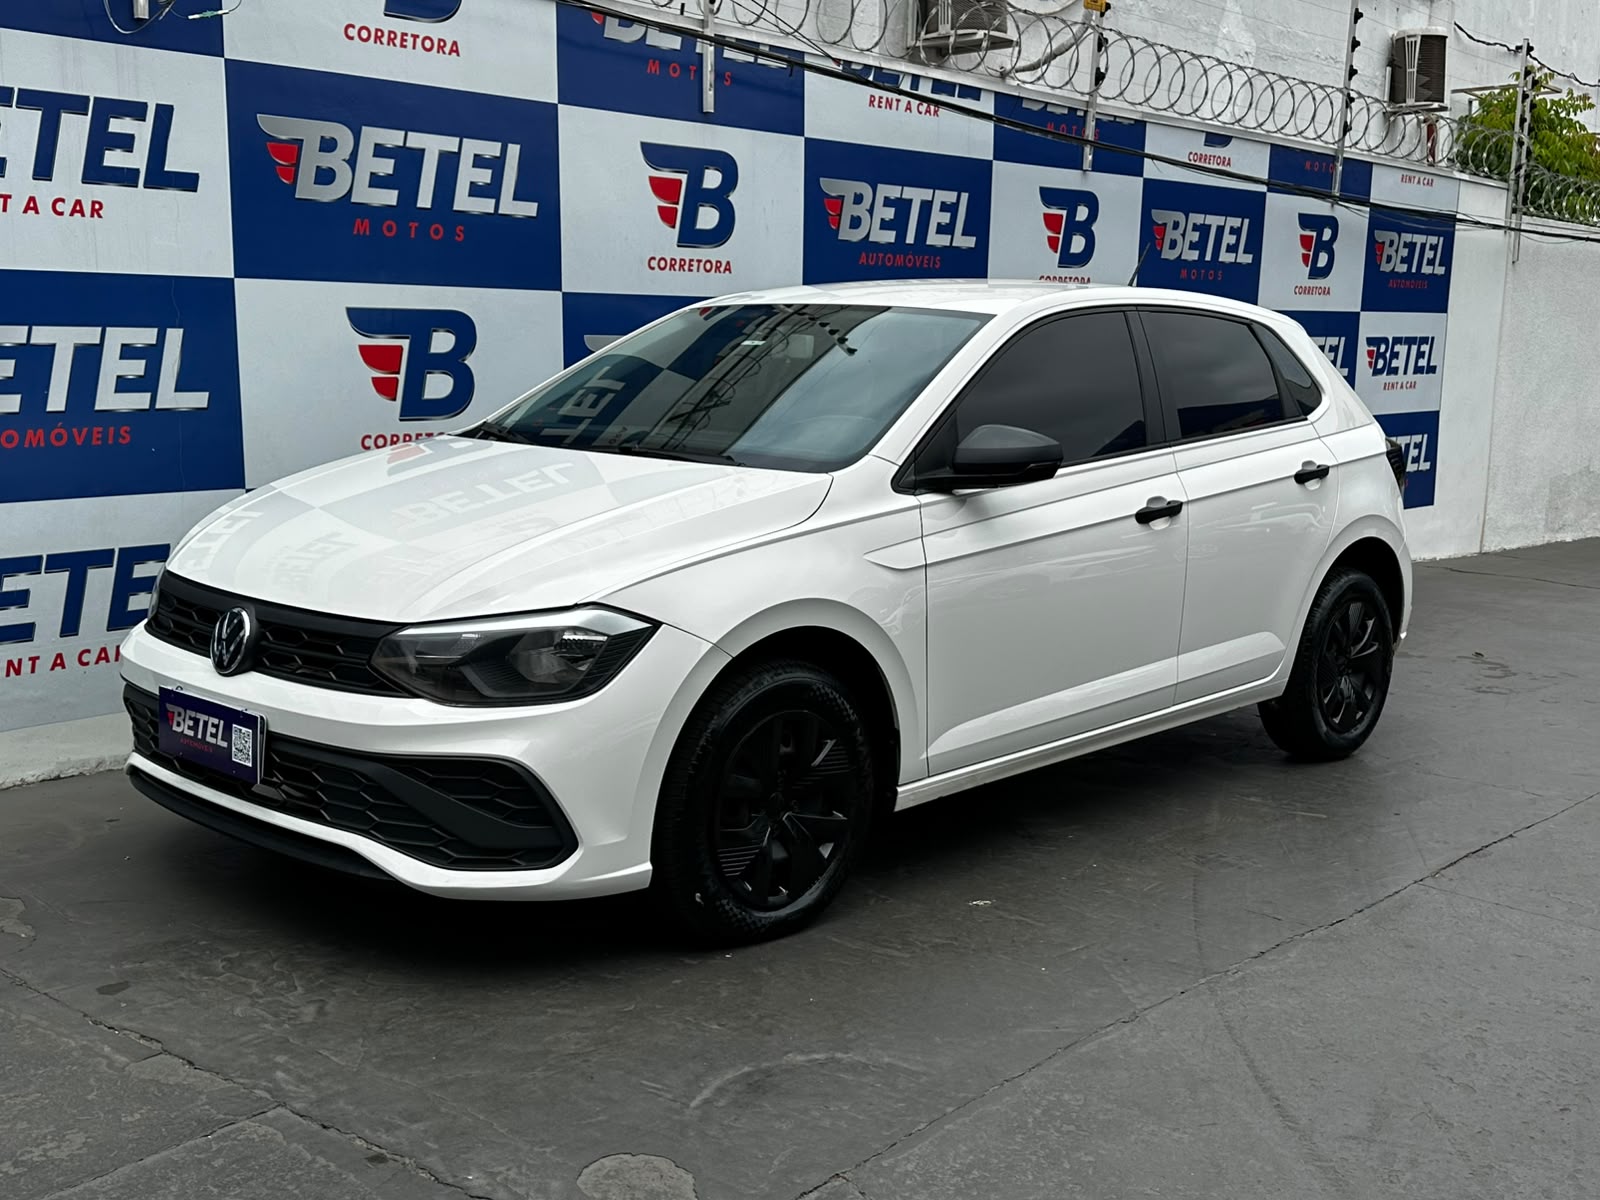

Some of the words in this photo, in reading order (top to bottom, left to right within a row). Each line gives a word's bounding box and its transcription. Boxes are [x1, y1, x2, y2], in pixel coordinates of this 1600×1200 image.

[343, 23, 461, 57] CORRETORA
[647, 59, 732, 87] MOTS
[868, 95, 901, 112] RENT
[904, 100, 913, 113] A
[917, 103, 940, 118] CAR
[0, 86, 200, 193] TEL
[257, 114, 538, 218] BETEL
[1187, 151, 1232, 168] CORRETORA
[1305, 161, 1335, 173] MOTO
[1401, 174, 1416, 184] RENT
[1422, 177, 1434, 187] CAR
[22, 196, 40, 215] A
[51, 197, 104, 218] CAR
[819, 177, 976, 248] BETEL
[352, 218, 465, 242] MOTOS
[1151, 209, 1254, 264] BETEL
[859, 251, 942, 269] AUTOMÓVEIS
[1374, 229, 1446, 275] BETEL
[647, 256, 732, 275] CORRETORA
[1180, 268, 1223, 280] MOTOS
[1294, 285, 1331, 296] CORRETORA
[1366, 336, 1437, 377] BETEL
[1383, 381, 1398, 391] RENT
[1405, 380, 1417, 390] CAR
[1386, 434, 1431, 472] TEL
[0, 543, 171, 645] ETE
[50, 652, 66, 671] A
[165, 703, 228, 748] BETEL
